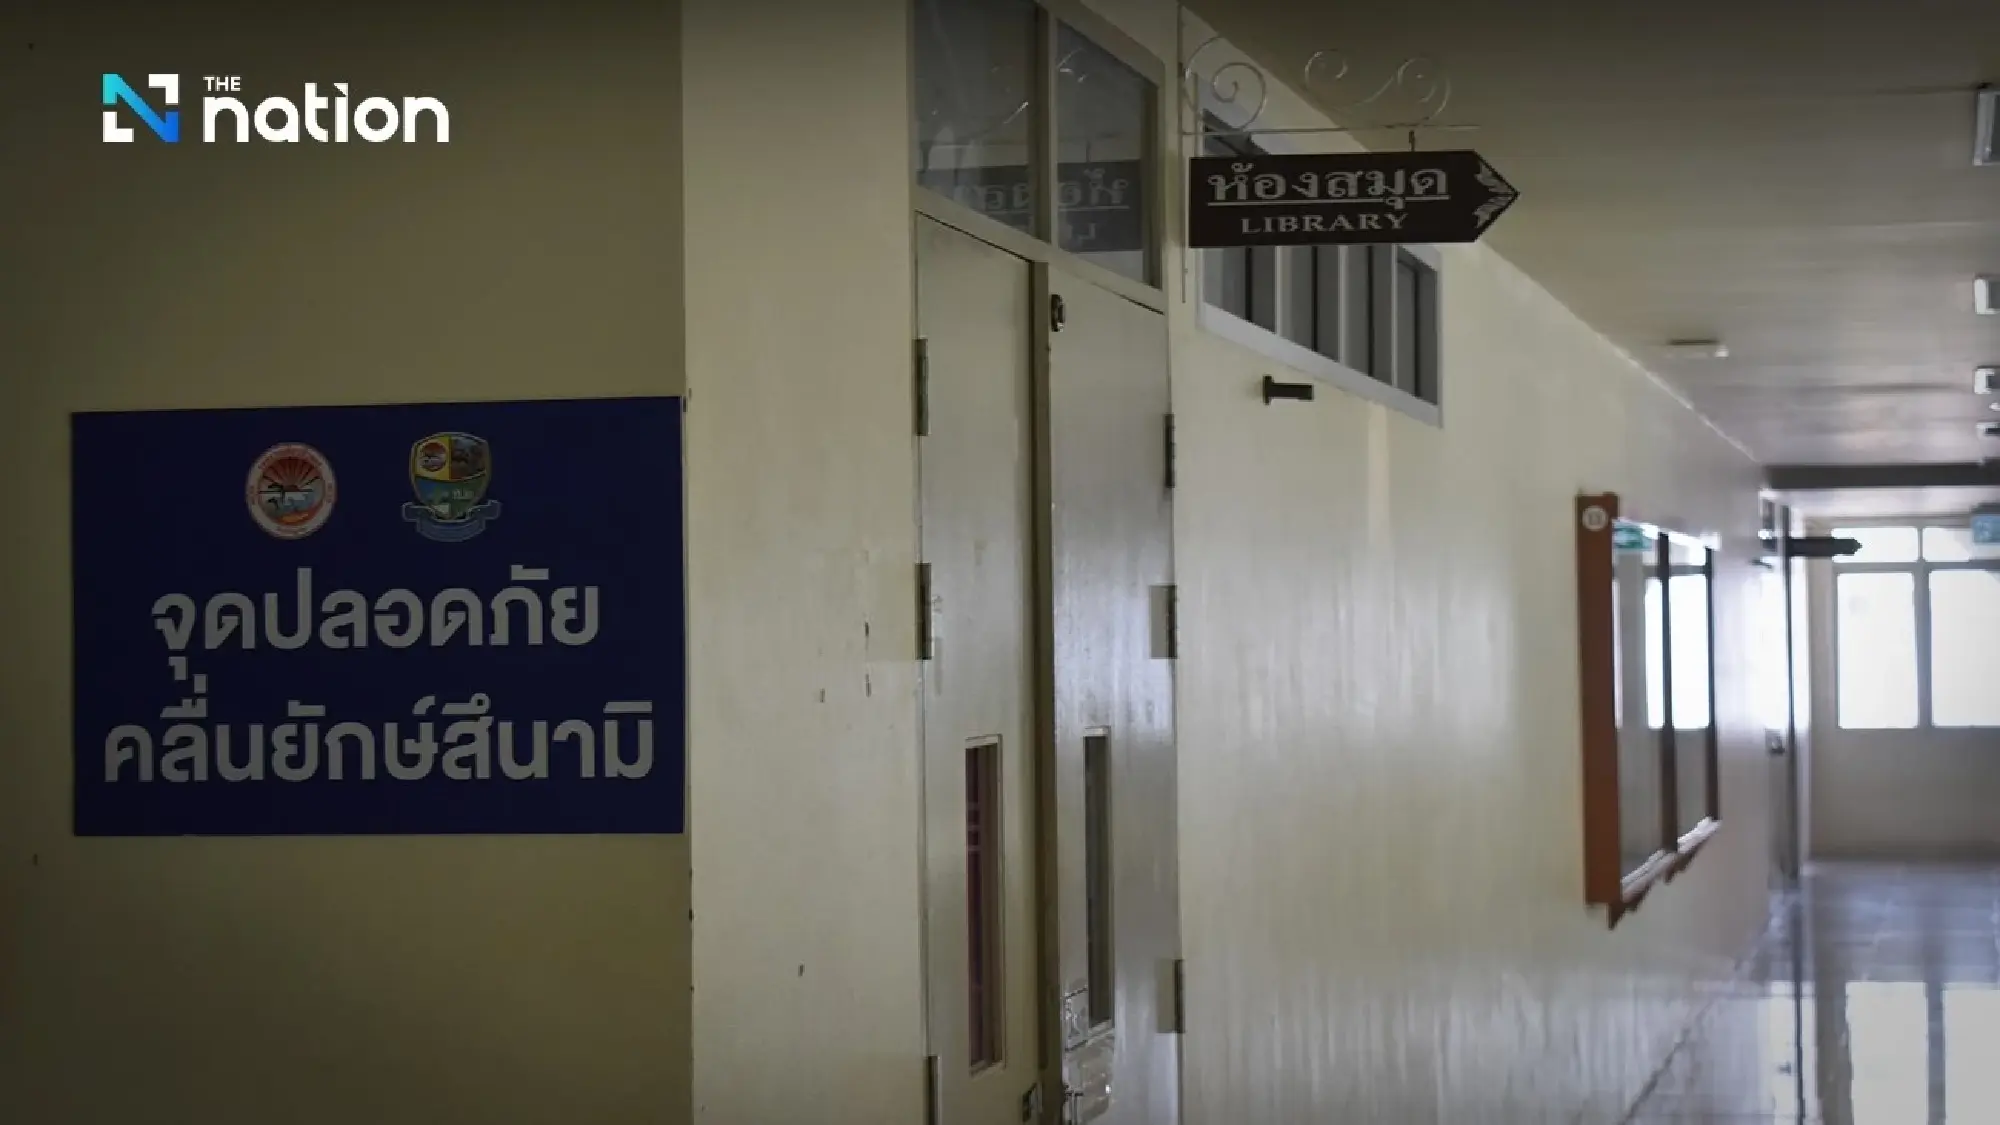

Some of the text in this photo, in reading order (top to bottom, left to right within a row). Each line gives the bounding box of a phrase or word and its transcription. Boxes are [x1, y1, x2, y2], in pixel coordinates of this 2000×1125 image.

[1206, 161, 1449, 210] ห้องสมุด
[1240, 211, 1409, 234] LIBRARY
[151, 564, 600, 680] จุดปลอดภัย
[103, 674, 654, 782] คลื่นยักษ์สึนามิ
